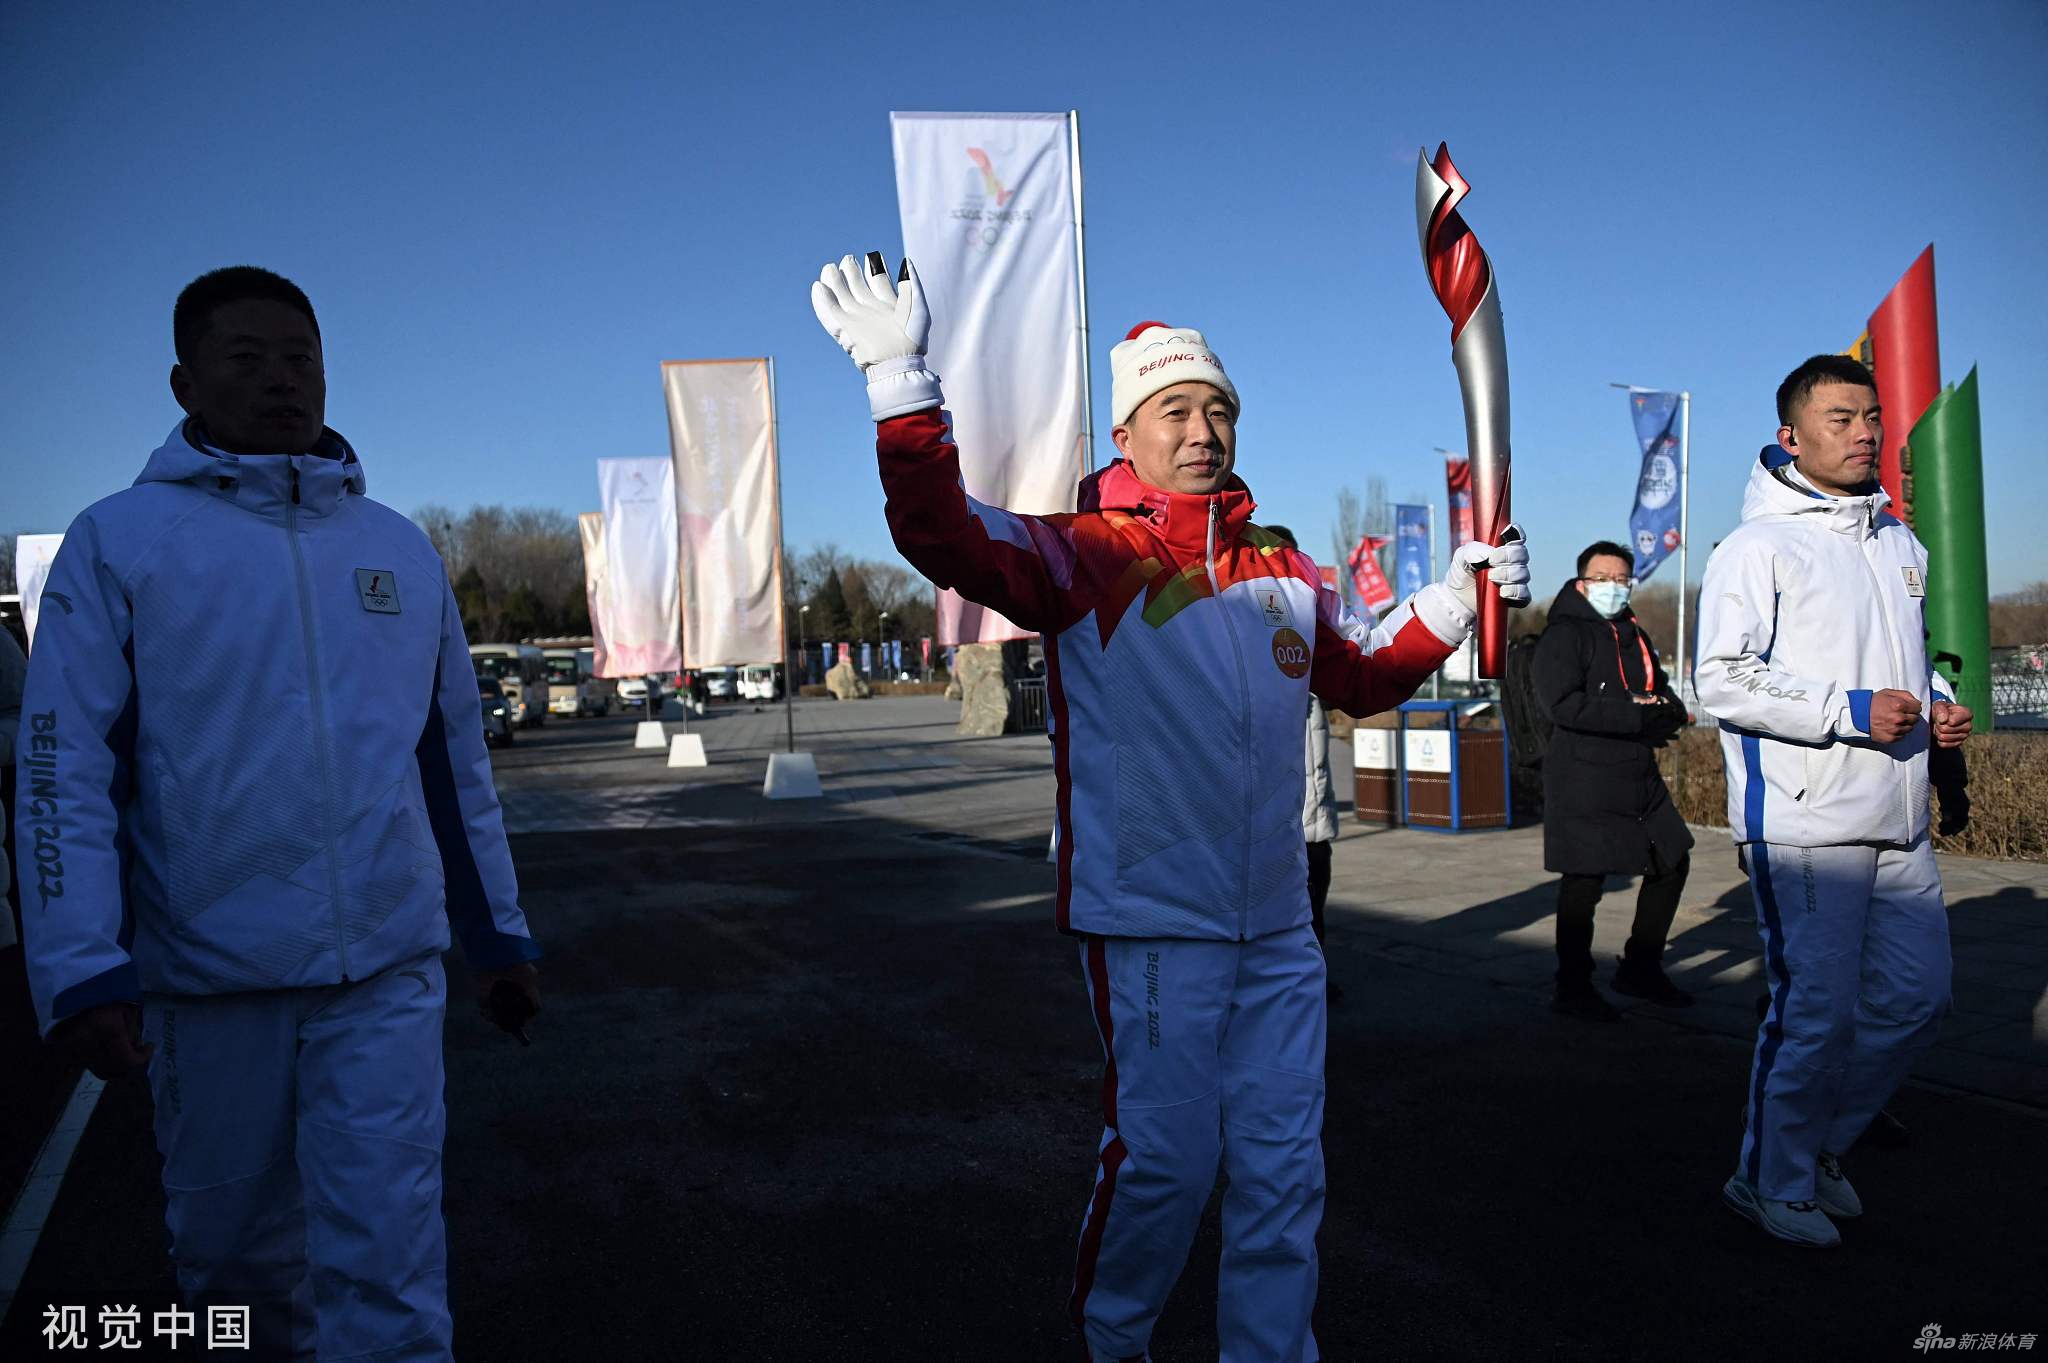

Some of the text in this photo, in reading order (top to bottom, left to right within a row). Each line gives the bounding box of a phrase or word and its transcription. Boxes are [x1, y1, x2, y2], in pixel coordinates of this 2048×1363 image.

[1138, 353, 1194, 376] BEIJING
[1276, 646, 1306, 664] 002
[23, 709, 65, 911] BEIJING 2022
[1799, 847, 1816, 914] EIJING 2022
[1143, 952, 1160, 1050] BEIJING 2022
